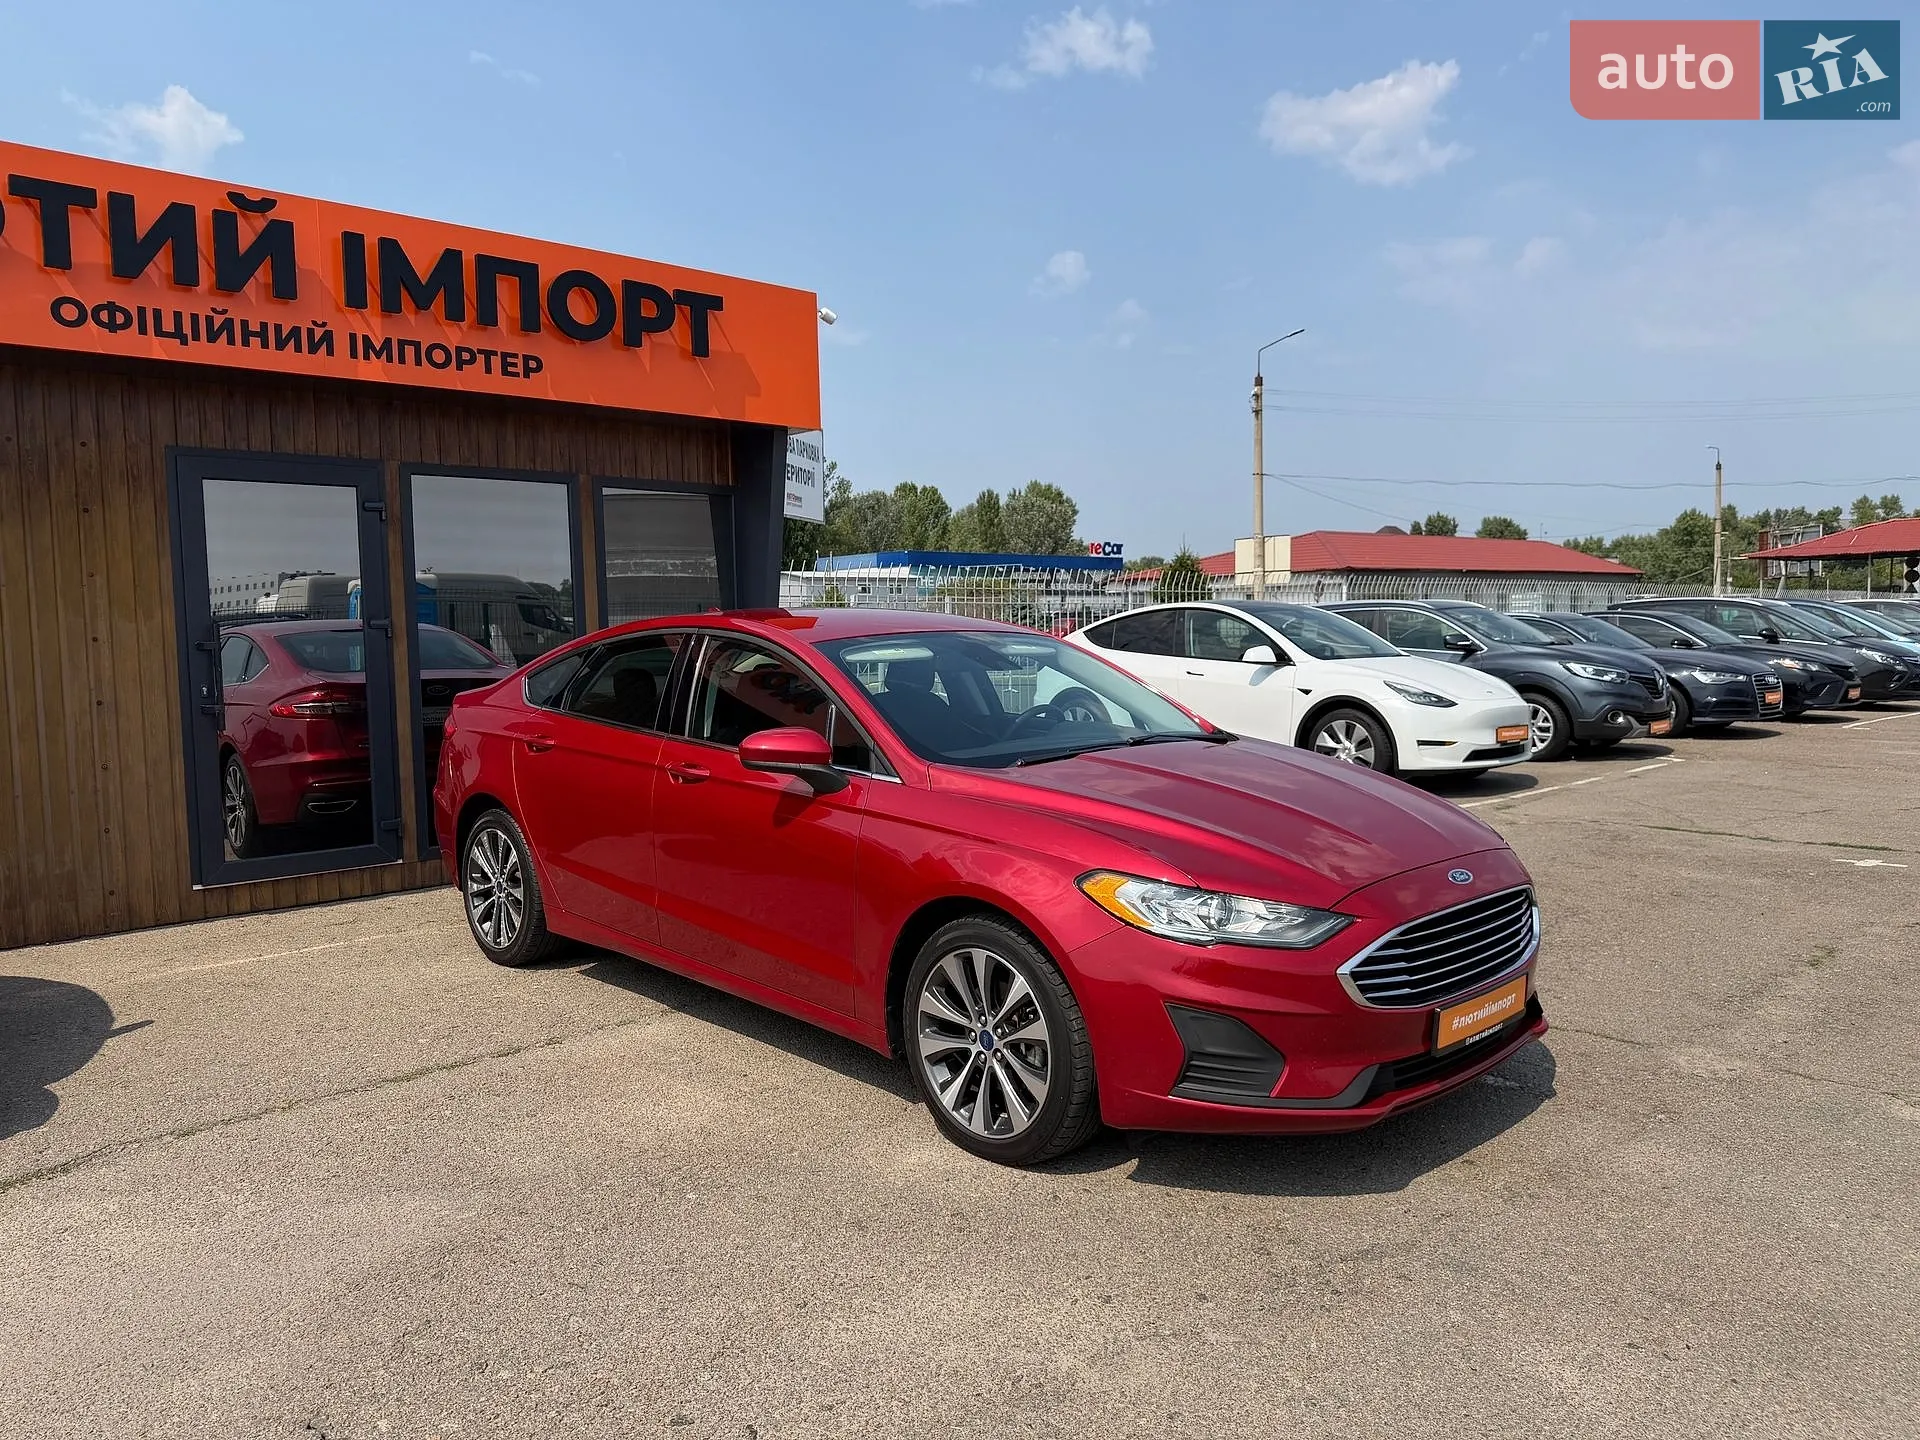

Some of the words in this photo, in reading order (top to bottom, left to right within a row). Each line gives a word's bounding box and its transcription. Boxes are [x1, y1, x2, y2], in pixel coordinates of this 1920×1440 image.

[0, 174, 298, 301] ТИЙ
[342, 231, 724, 358] ІМПОРТ
[50, 296, 335, 357] ОФІЦІЙНИЙ
[349, 333, 544, 379] ІМПОРТЕР
